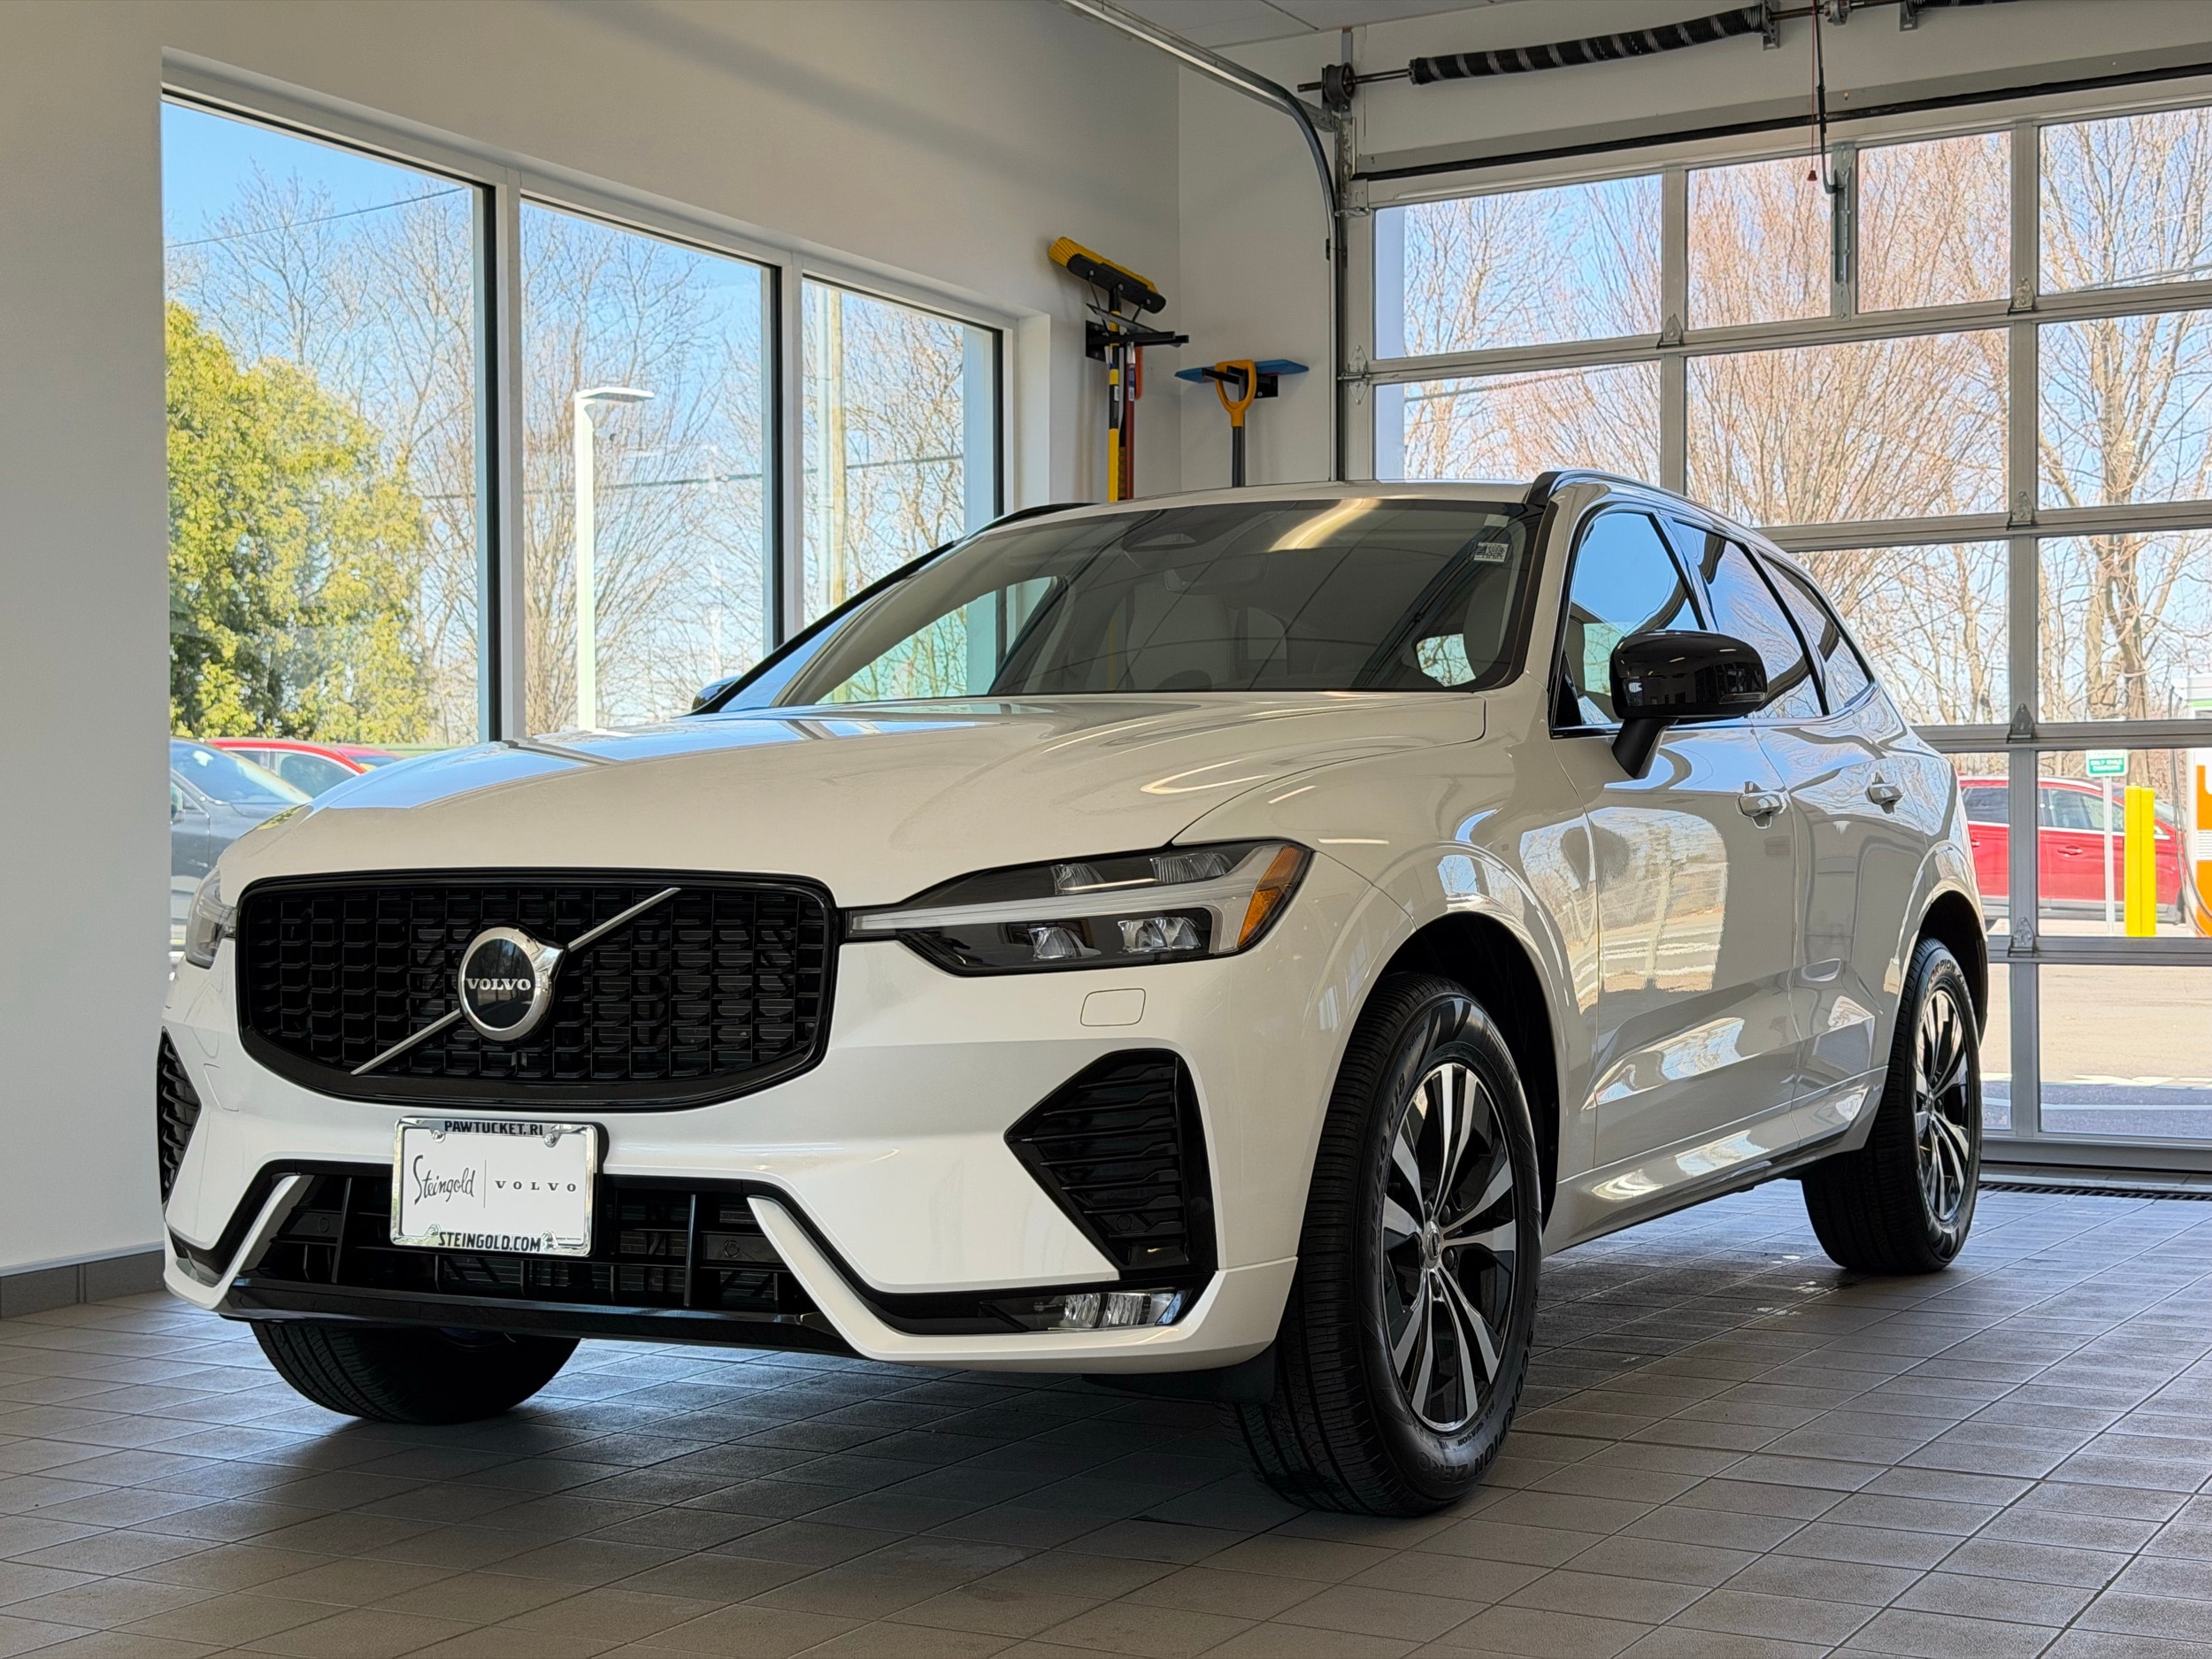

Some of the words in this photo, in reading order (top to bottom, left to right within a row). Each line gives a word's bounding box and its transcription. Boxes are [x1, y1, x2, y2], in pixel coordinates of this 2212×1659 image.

[465, 978, 532, 991] VOLVO
[444, 1120, 527, 1136] PAWTUCKET,
[529, 1124, 544, 1136] RI
[412, 1154, 476, 1205] Steingold
[495, 1179, 577, 1193] VOLVO
[438, 1231, 541, 1252] STEINGOLD.COM
[1457, 1421, 1484, 1447] SEASON
